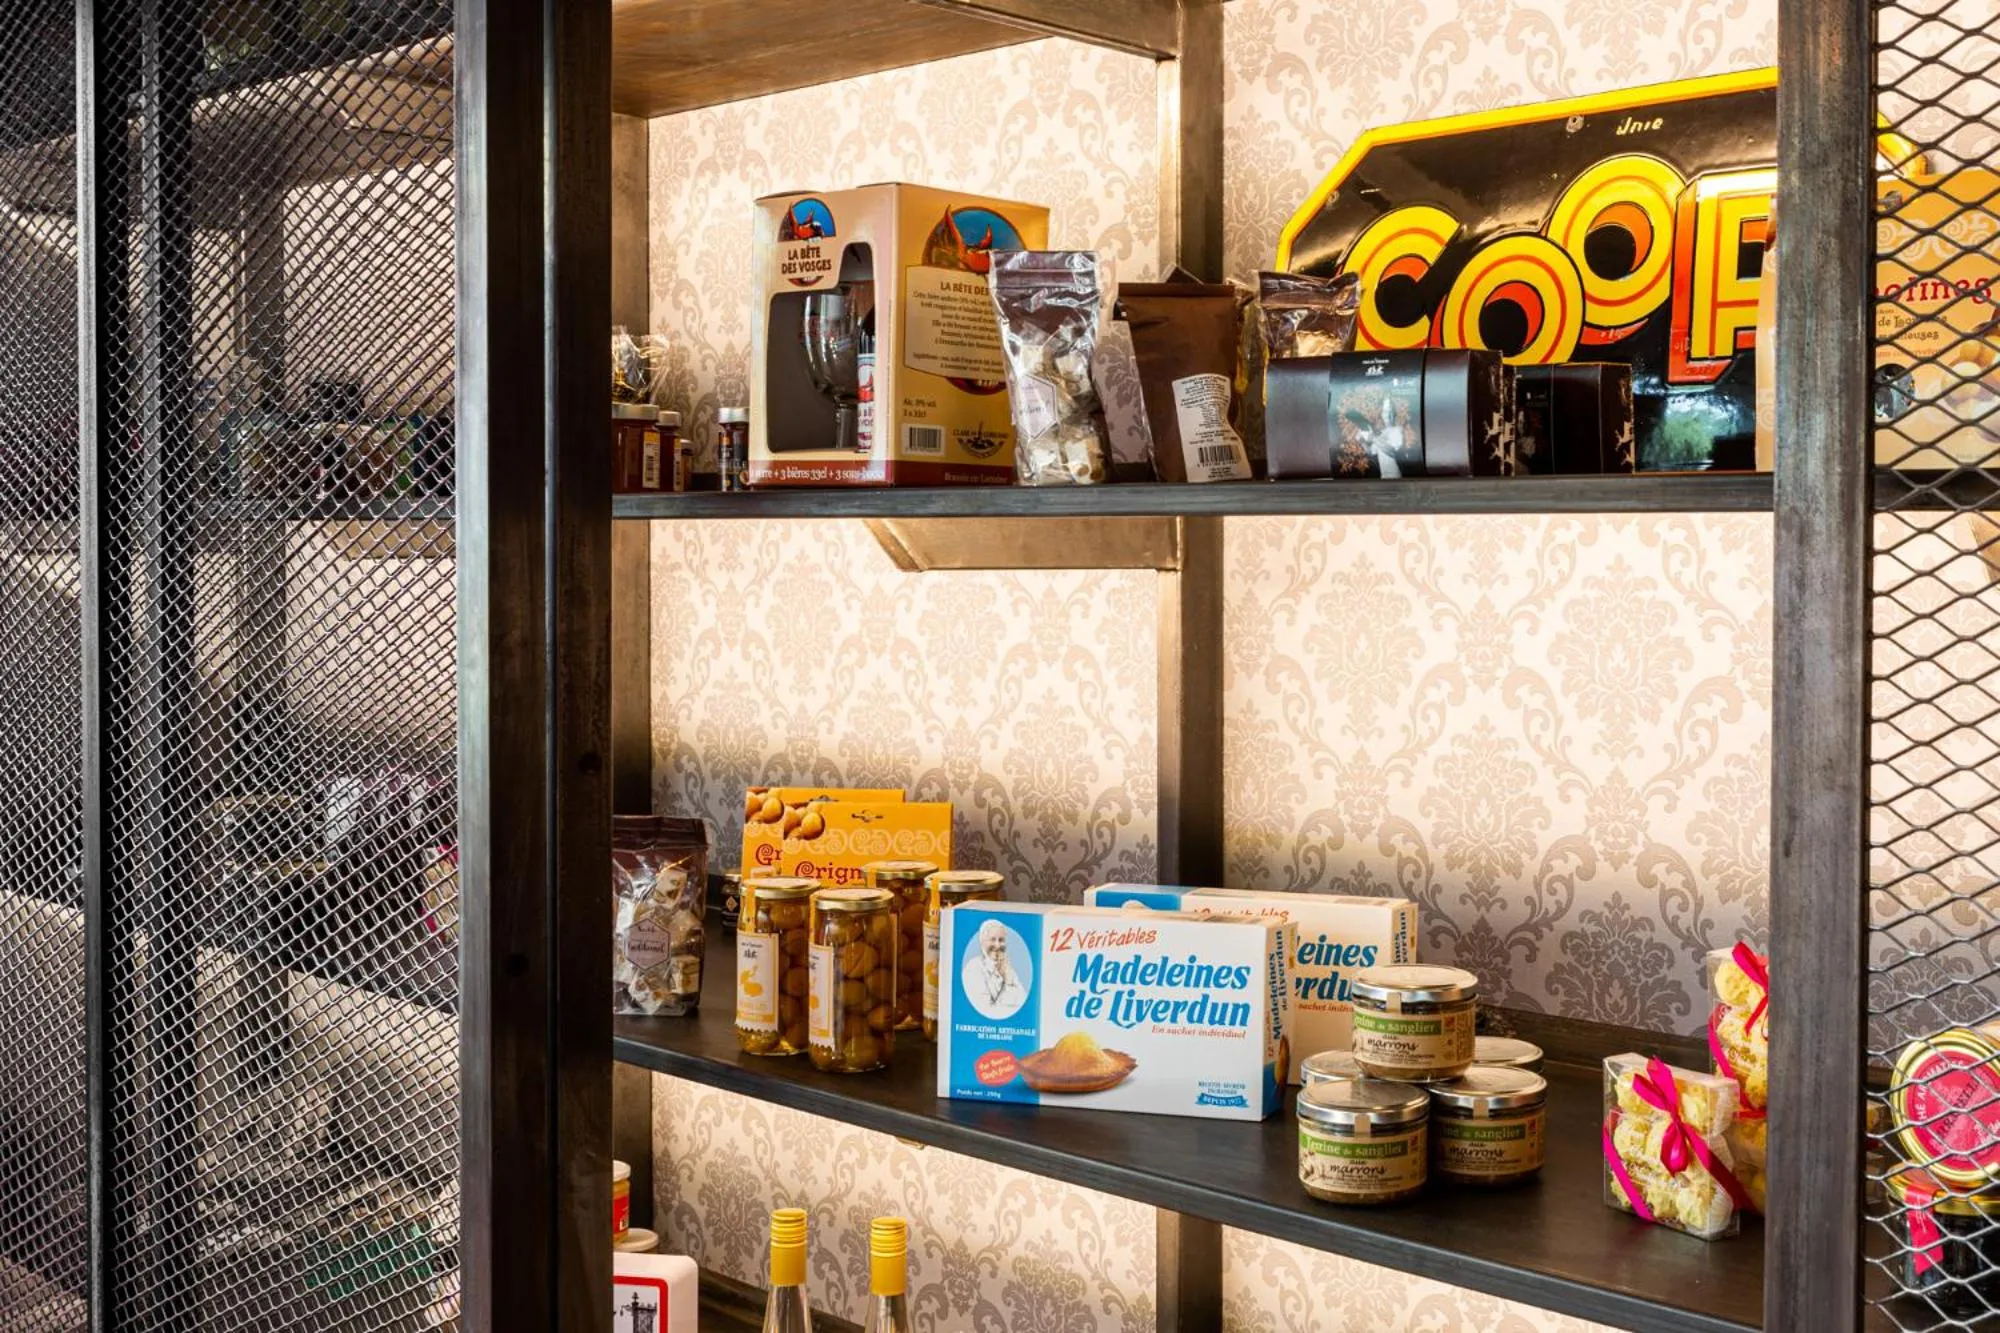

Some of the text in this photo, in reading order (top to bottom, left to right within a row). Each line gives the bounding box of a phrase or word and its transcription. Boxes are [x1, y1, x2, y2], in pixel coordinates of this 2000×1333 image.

[787, 245, 821, 260] LA BÊTE
[1340, 153, 1778, 366] COOP
[781, 259, 832, 274] DES VOSGES
[940, 281, 951, 291] LA
[952, 282, 972, 294] BÊTE
[1050, 927, 1158, 952] 12 Véritables
[1297, 934, 1379, 967] eines
[1071, 953, 1252, 994] Madeleines
[1108, 988, 1251, 1029] Liverdun
[1386, 1020, 1437, 1034] sanglier
[1366, 1038, 1420, 1052] marrons
[1473, 1126, 1521, 1141] sanglier
[1449, 1146, 1505, 1159] marrons
[1329, 1163, 1388, 1175] marrons
